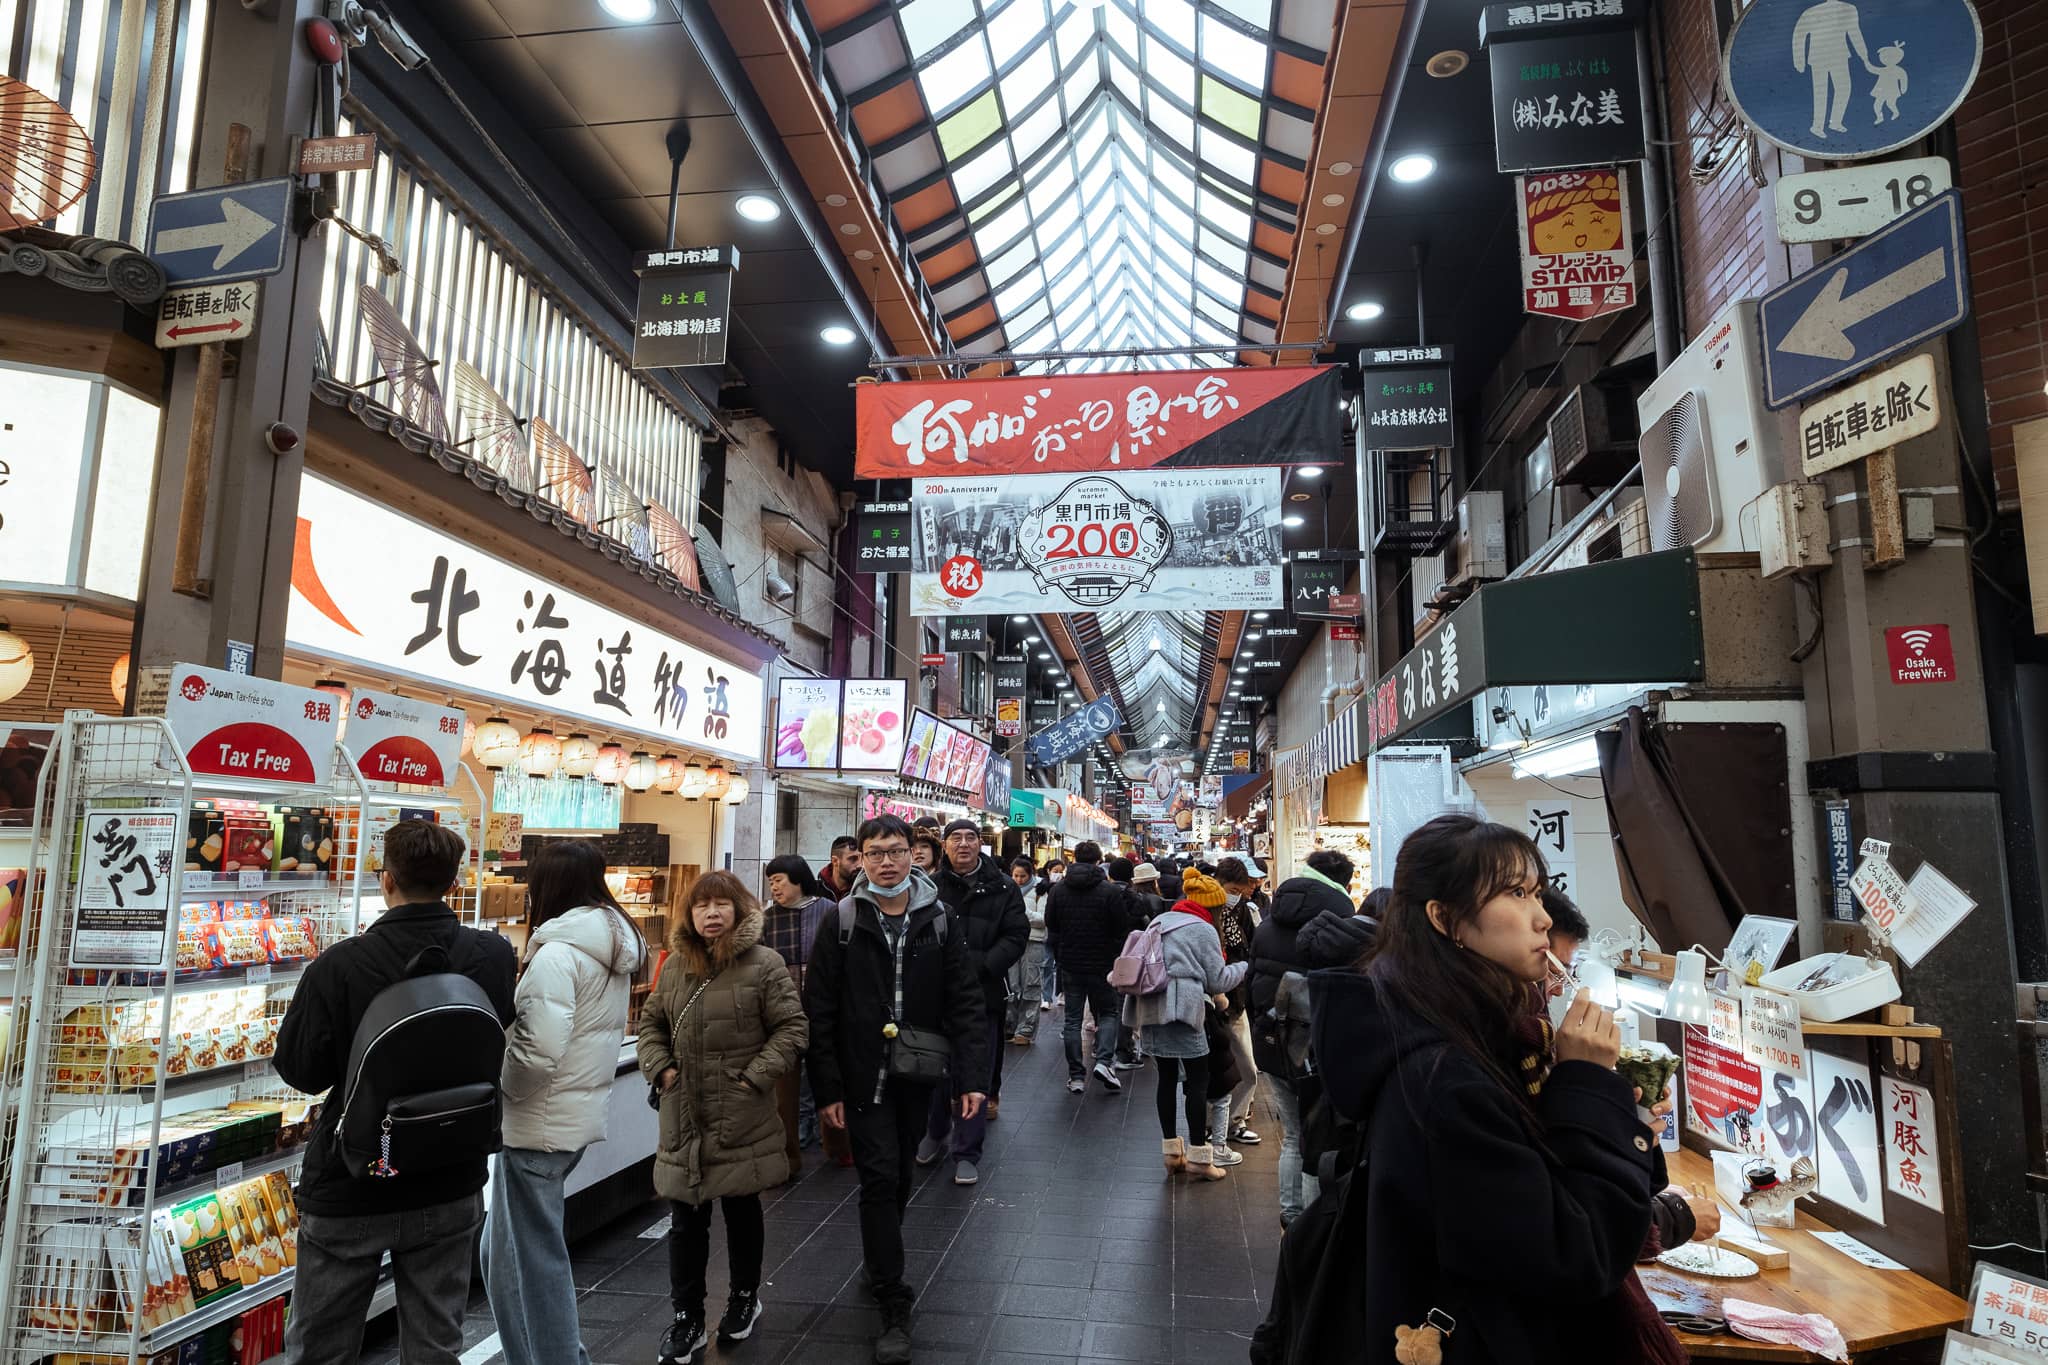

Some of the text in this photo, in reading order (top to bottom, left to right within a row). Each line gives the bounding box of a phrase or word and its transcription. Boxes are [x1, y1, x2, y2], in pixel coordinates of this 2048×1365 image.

[1508, 0, 1623, 25] 黒門市場
[1512, 88, 1625, 133] (株)みな美
[302, 143, 366, 165] 非常警報装置
[1528, 174, 1587, 198] クロモン
[648, 248, 719, 267] 黒門市場
[1538, 252, 1614, 269] フレッシュ
[1531, 265, 1626, 286] STAMP
[162, 287, 252, 321] 自転車を除く
[660, 291, 706, 305] お土産
[1533, 286, 1627, 308] 加盟店
[641, 318, 721, 337] 北海道物語
[1704, 323, 1731, 353] TOSHIBA
[1374, 348, 1441, 362] 黒門市場
[1371, 407, 1448, 426] 山長商店株式会社
[1804, 381, 1931, 461] 自転車を除く
[951, 485, 998, 494] Anniversary
[1153, 478, 1266, 488] 今後ともよろしくお願い致します
[1055, 502, 1131, 522] 黒門市場
[1046, 522, 1139, 559] 200
[1119, 531, 1130, 551] 周年
[861, 546, 909, 558] おた福堂
[946, 560, 981, 591] 祝
[1051, 561, 1135, 574] 感謝の気持ちとともに
[404, 556, 729, 740] 北海道物語
[1403, 622, 1459, 720] みな美
[1906, 657, 1936, 668] Osaka
[1898, 669, 1920, 680] Free
[787, 686, 823, 695] さつまいも
[850, 686, 891, 696] いちご大福
[304, 700, 331, 723] 免税
[439, 715, 459, 735] 免税
[220, 744, 291, 772] Tax Free
[378, 754, 427, 776] Tax Free
[1830, 810, 1854, 921] 防犯カメラ設置
[1861, 881, 1896, 929] 1080
[1714, 998, 1733, 1014] please
[1711, 1025, 1726, 1041] Cash
[1768, 1024, 1788, 1044] 사시미
[1775, 1018, 1797, 1032] sashimi
[1791, 1054, 1801, 1070] 円
[1891, 1082, 1928, 1199] 河豚魚
[1986, 1318, 2016, 1339] 1包
